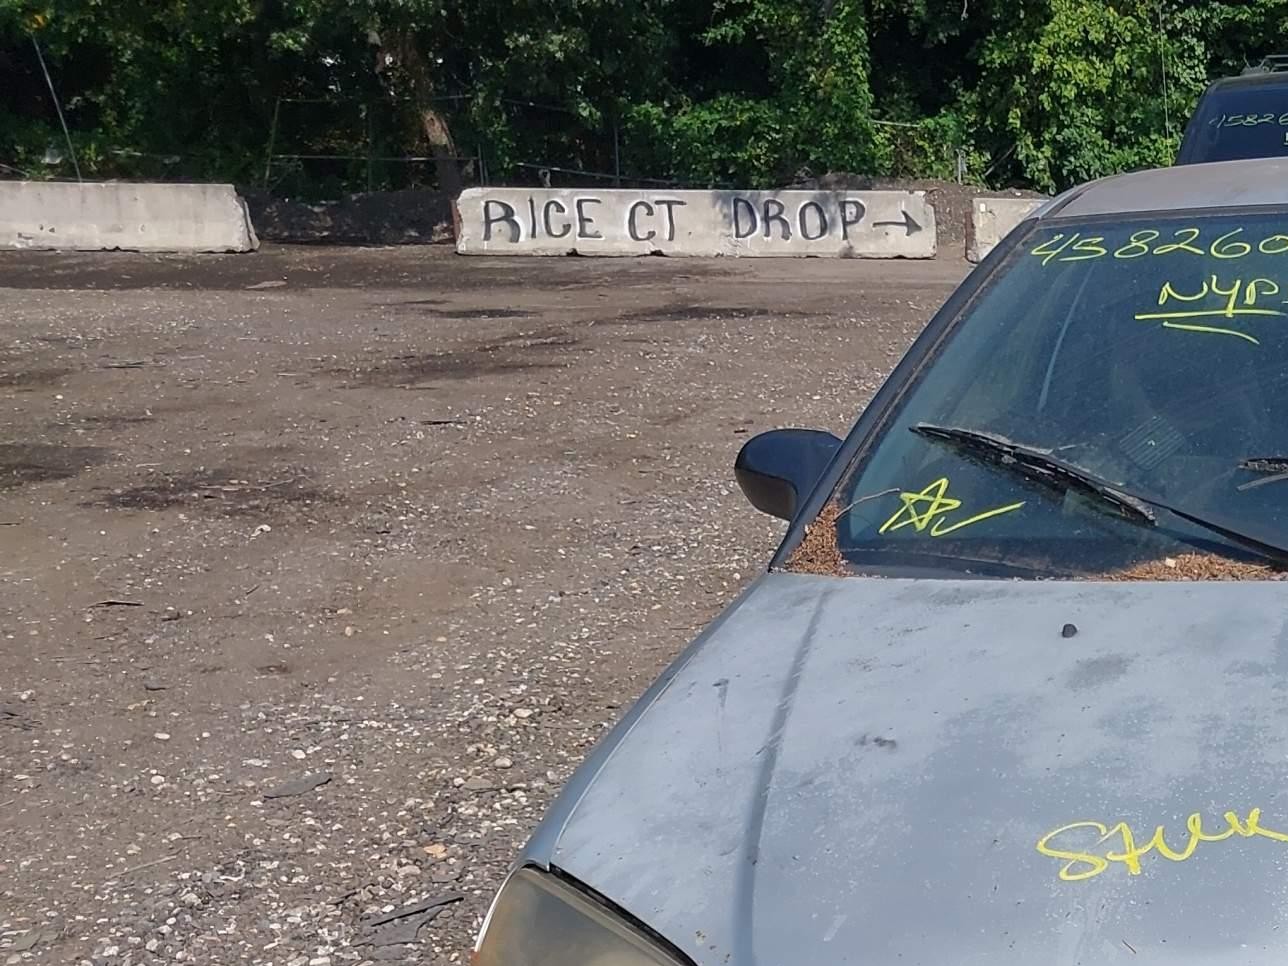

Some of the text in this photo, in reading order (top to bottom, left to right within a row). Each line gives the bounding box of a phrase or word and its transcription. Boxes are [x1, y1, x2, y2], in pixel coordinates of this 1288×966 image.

[483, 198, 865, 243] RICE CT DROP
